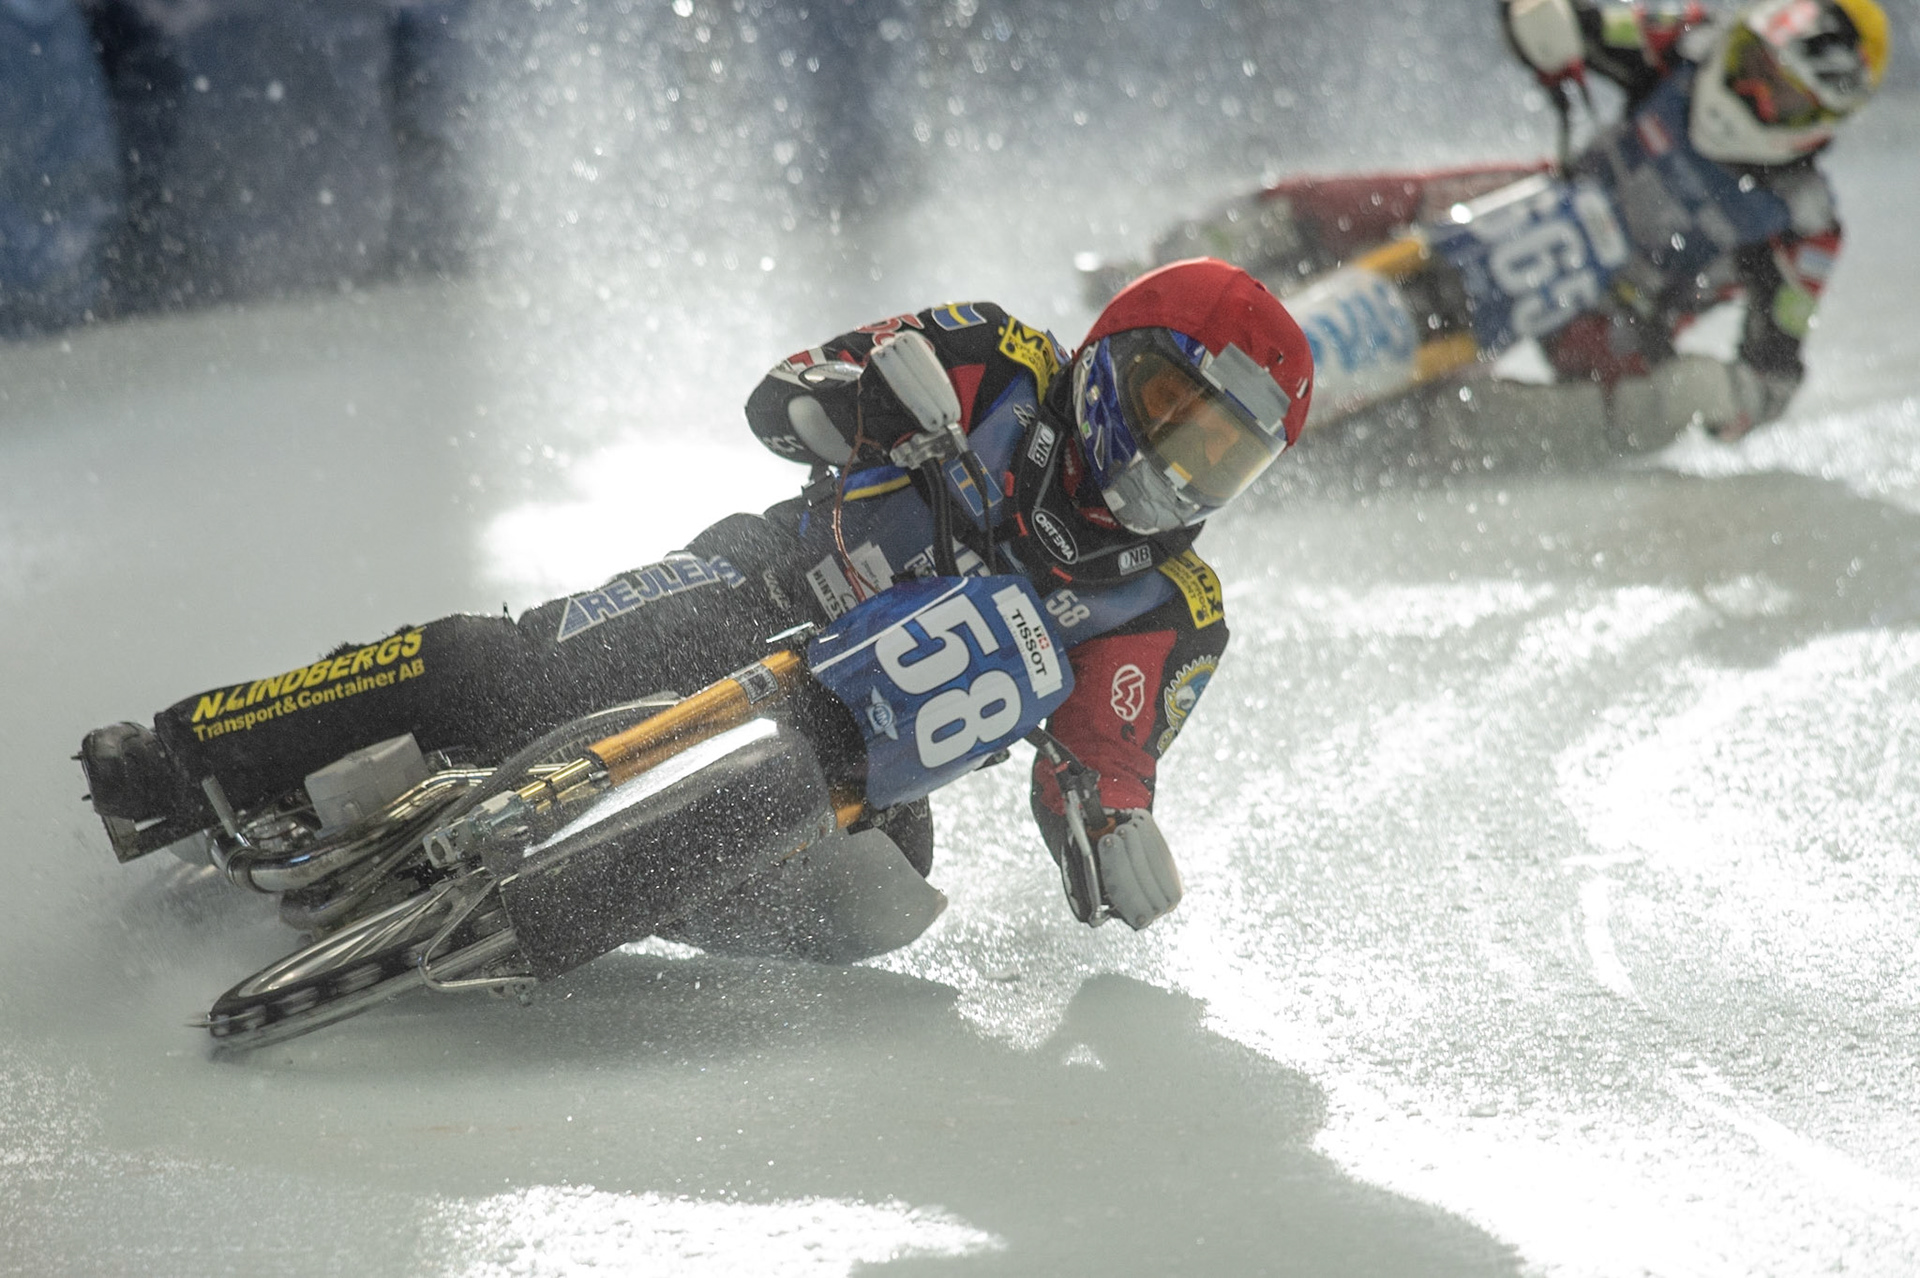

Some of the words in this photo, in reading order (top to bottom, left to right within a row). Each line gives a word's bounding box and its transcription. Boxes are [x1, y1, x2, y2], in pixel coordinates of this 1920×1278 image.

[1035, 513, 1074, 560] ORTEMA
[1011, 608, 1047, 677] TISSOT
[1045, 589, 1091, 628] 58
[191, 626, 427, 723] N.LINDBERGS
[193, 667, 396, 742] Transport&Container
[399, 658, 425, 681] AB
[875, 593, 1022, 769] 58
